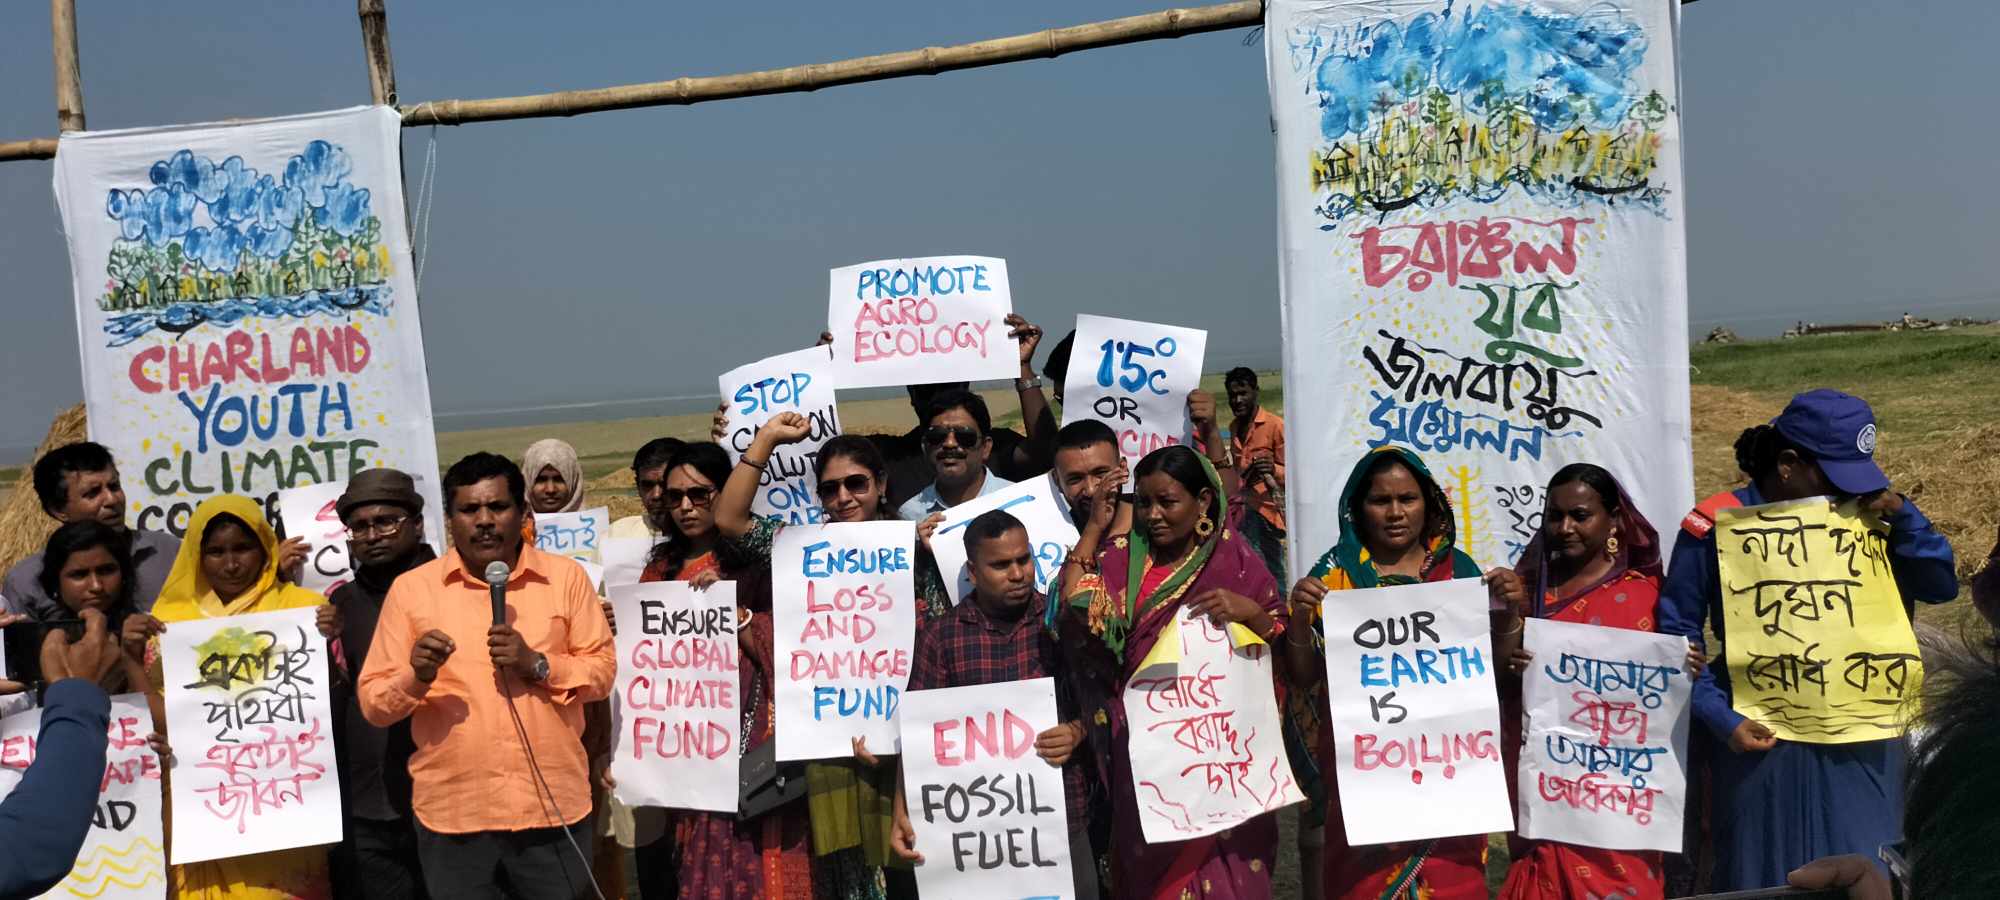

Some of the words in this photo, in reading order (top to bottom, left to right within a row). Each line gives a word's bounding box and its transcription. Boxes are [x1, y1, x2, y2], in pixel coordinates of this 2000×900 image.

[1349, 215, 1595, 292] চরাঞ্চল
[857, 264, 991, 300] PROMOTE
[855, 298, 937, 330] AGRO
[1459, 281, 1584, 368] যুব
[129, 325, 371, 393] CHARLAND
[854, 319, 991, 363] ECOLOGY
[734, 373, 811, 415] STOP
[1363, 328, 1603, 430] জলবায়ু
[178, 383, 353, 453] YOUTH
[1093, 396, 1142, 424] OR
[1368, 390, 1584, 462] সম্মেলন
[145, 440, 379, 495] CLIMATE
[767, 479, 811, 510] ON
[802, 540, 910, 578] ENSURE
[1730, 510, 1827, 567] নদী
[640, 600, 734, 638] ENSURE
[806, 580, 894, 614] LOSS
[800, 614, 877, 644] AND
[1353, 610, 1440, 650] OUR
[183, 625, 316, 690] একটাই
[631, 638, 738, 672] GLOBAL
[789, 649, 908, 682] DAMAGE
[1359, 645, 1486, 688] EARTH
[1844, 652, 1921, 698] কর
[627, 675, 733, 711] CLIMATE
[1544, 652, 1681, 709] আমার
[813, 685, 900, 721] FUND
[1370, 690, 1408, 724] IS
[633, 716, 731, 760] FUND
[932, 707, 1036, 767] END
[1546, 735, 1667, 789] আমার
[193, 771, 321, 834] জীবন
[921, 772, 1056, 824] FOSSIL
[951, 826, 1058, 873] FUEL
